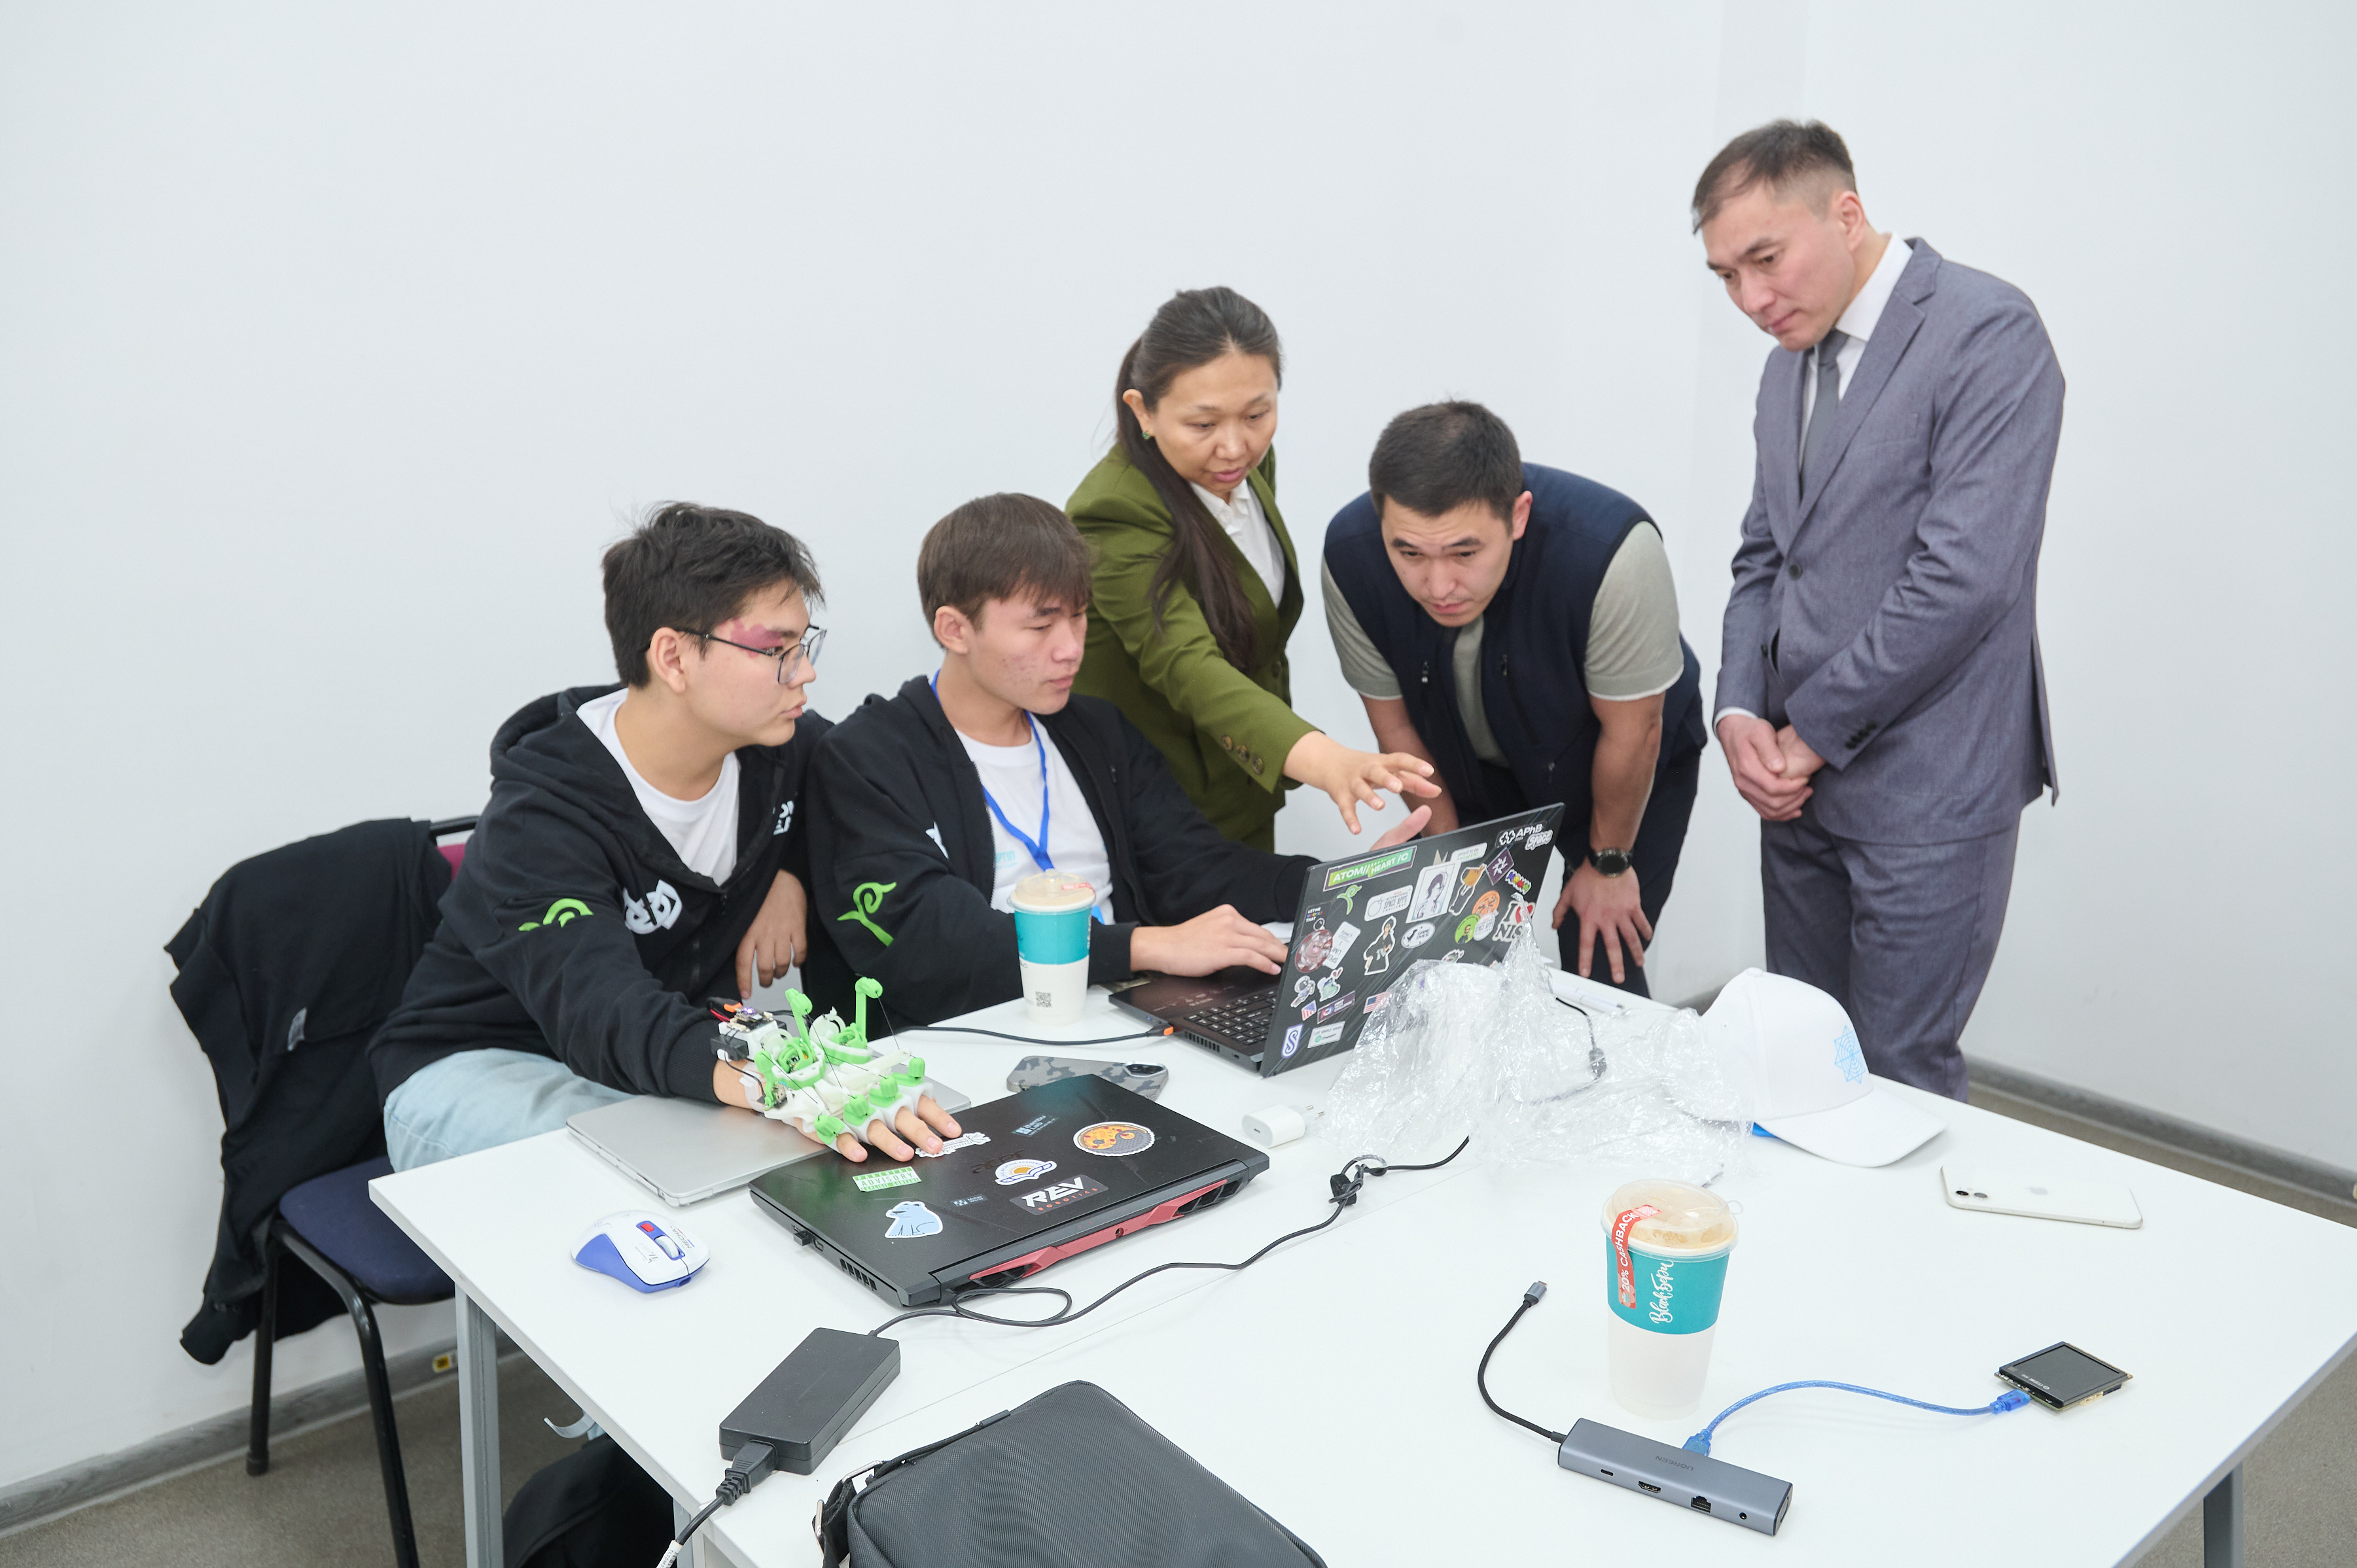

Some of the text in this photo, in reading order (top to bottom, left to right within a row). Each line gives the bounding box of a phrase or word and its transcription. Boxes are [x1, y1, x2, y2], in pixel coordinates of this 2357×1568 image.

[1515, 824, 1543, 837] APhB
[1525, 830, 1553, 850] Space
[1371, 858, 1396, 875] HEART
[1503, 903, 1517, 922] I
[943, 1141, 972, 1150] POTENTIAL
[971, 1149, 1025, 1174] acer
[859, 1168, 909, 1180] PARENTAL
[860, 1172, 912, 1187] ADVISORY
[1021, 1177, 1084, 1208] REV
[1038, 1188, 1097, 1211] ROBOTICS
[672, 1229, 692, 1249] MECHA
[1615, 1211, 1639, 1267] CASHBACK
[1655, 1455, 1693, 1471] UGREEN
